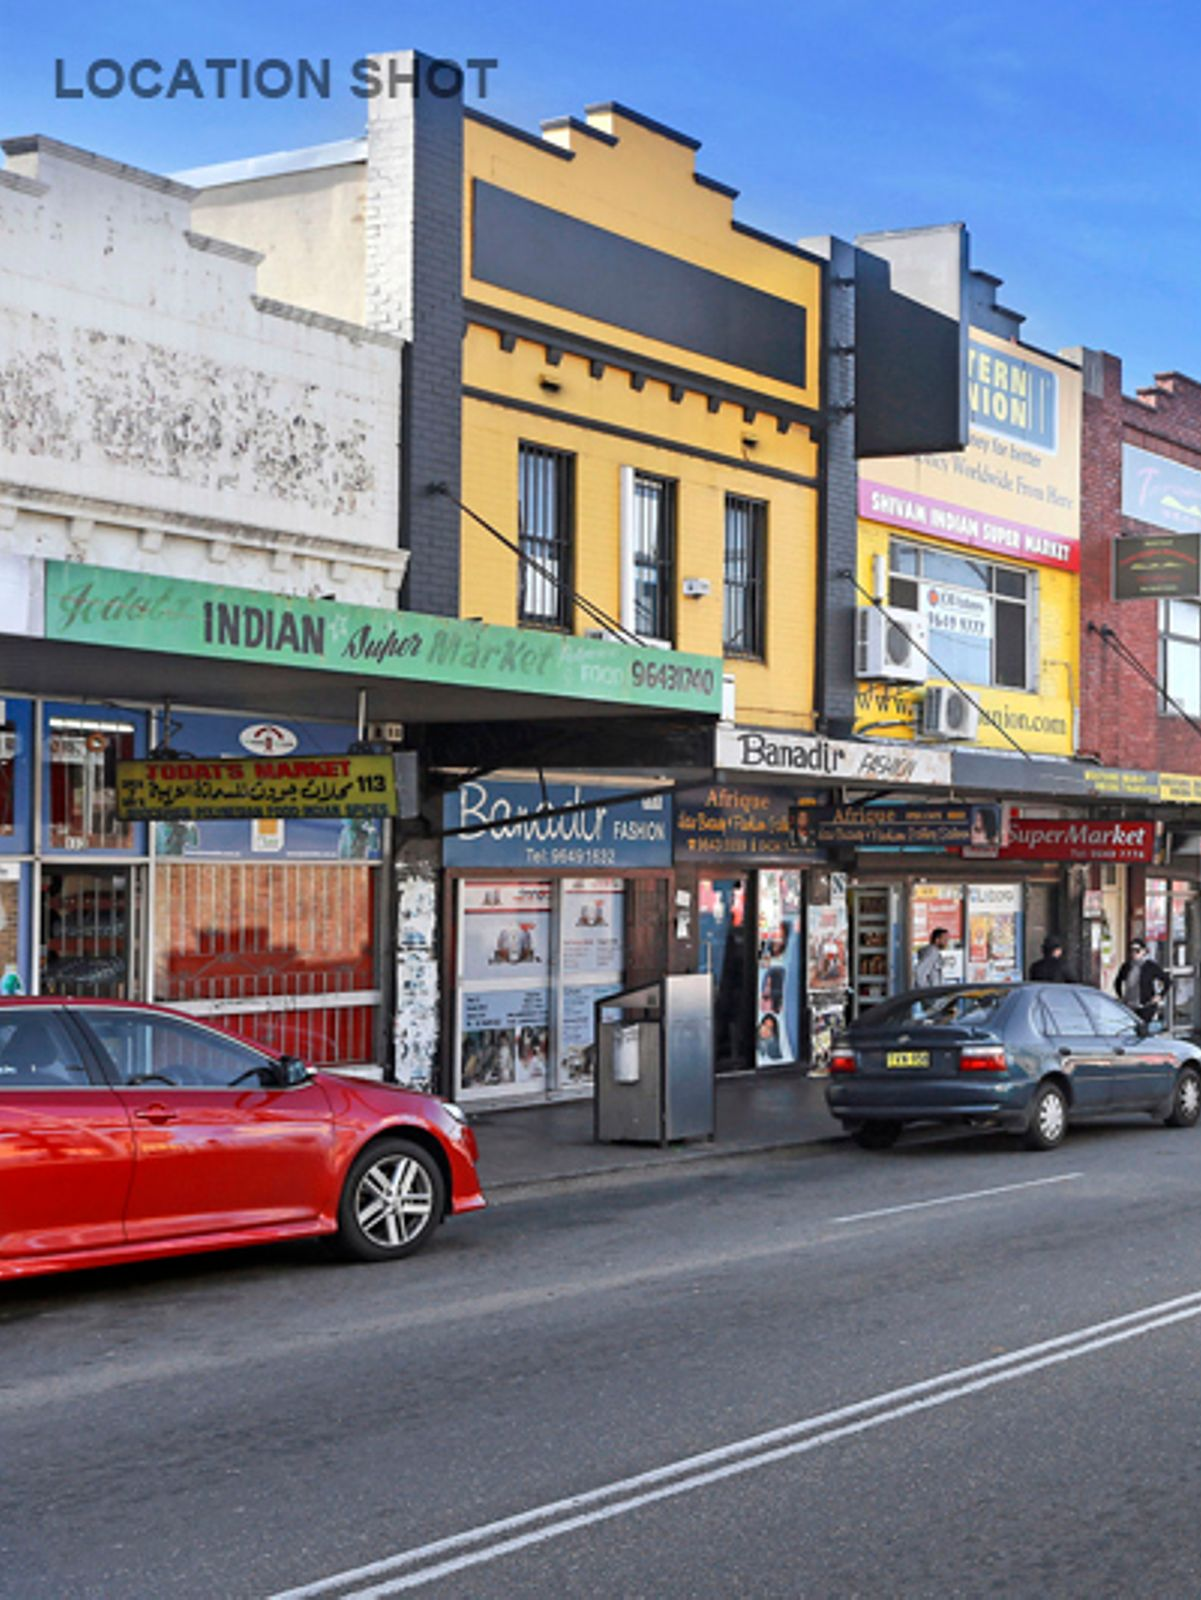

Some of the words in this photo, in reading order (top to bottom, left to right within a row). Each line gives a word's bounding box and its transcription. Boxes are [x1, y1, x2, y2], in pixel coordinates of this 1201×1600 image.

[968, 348, 1028, 397] TERN
[969, 380, 1028, 429] NION
[871, 491, 928, 525] SHIVAM
[929, 506, 980, 538] INDIAN
[982, 520, 1021, 549] SUPER
[1024, 531, 1071, 561] MARKET
[202, 601, 326, 656] INDIAN
[341, 624, 424, 665] Super
[736, 733, 846, 774] Banadir
[254, 760, 351, 780] MARKET
[357, 774, 387, 793] 113
[704, 787, 771, 813] Afrique
[832, 806, 897, 828] Afrique
[613, 820, 667, 841] FASHION
[1008, 823, 1147, 849] SuperMarket
